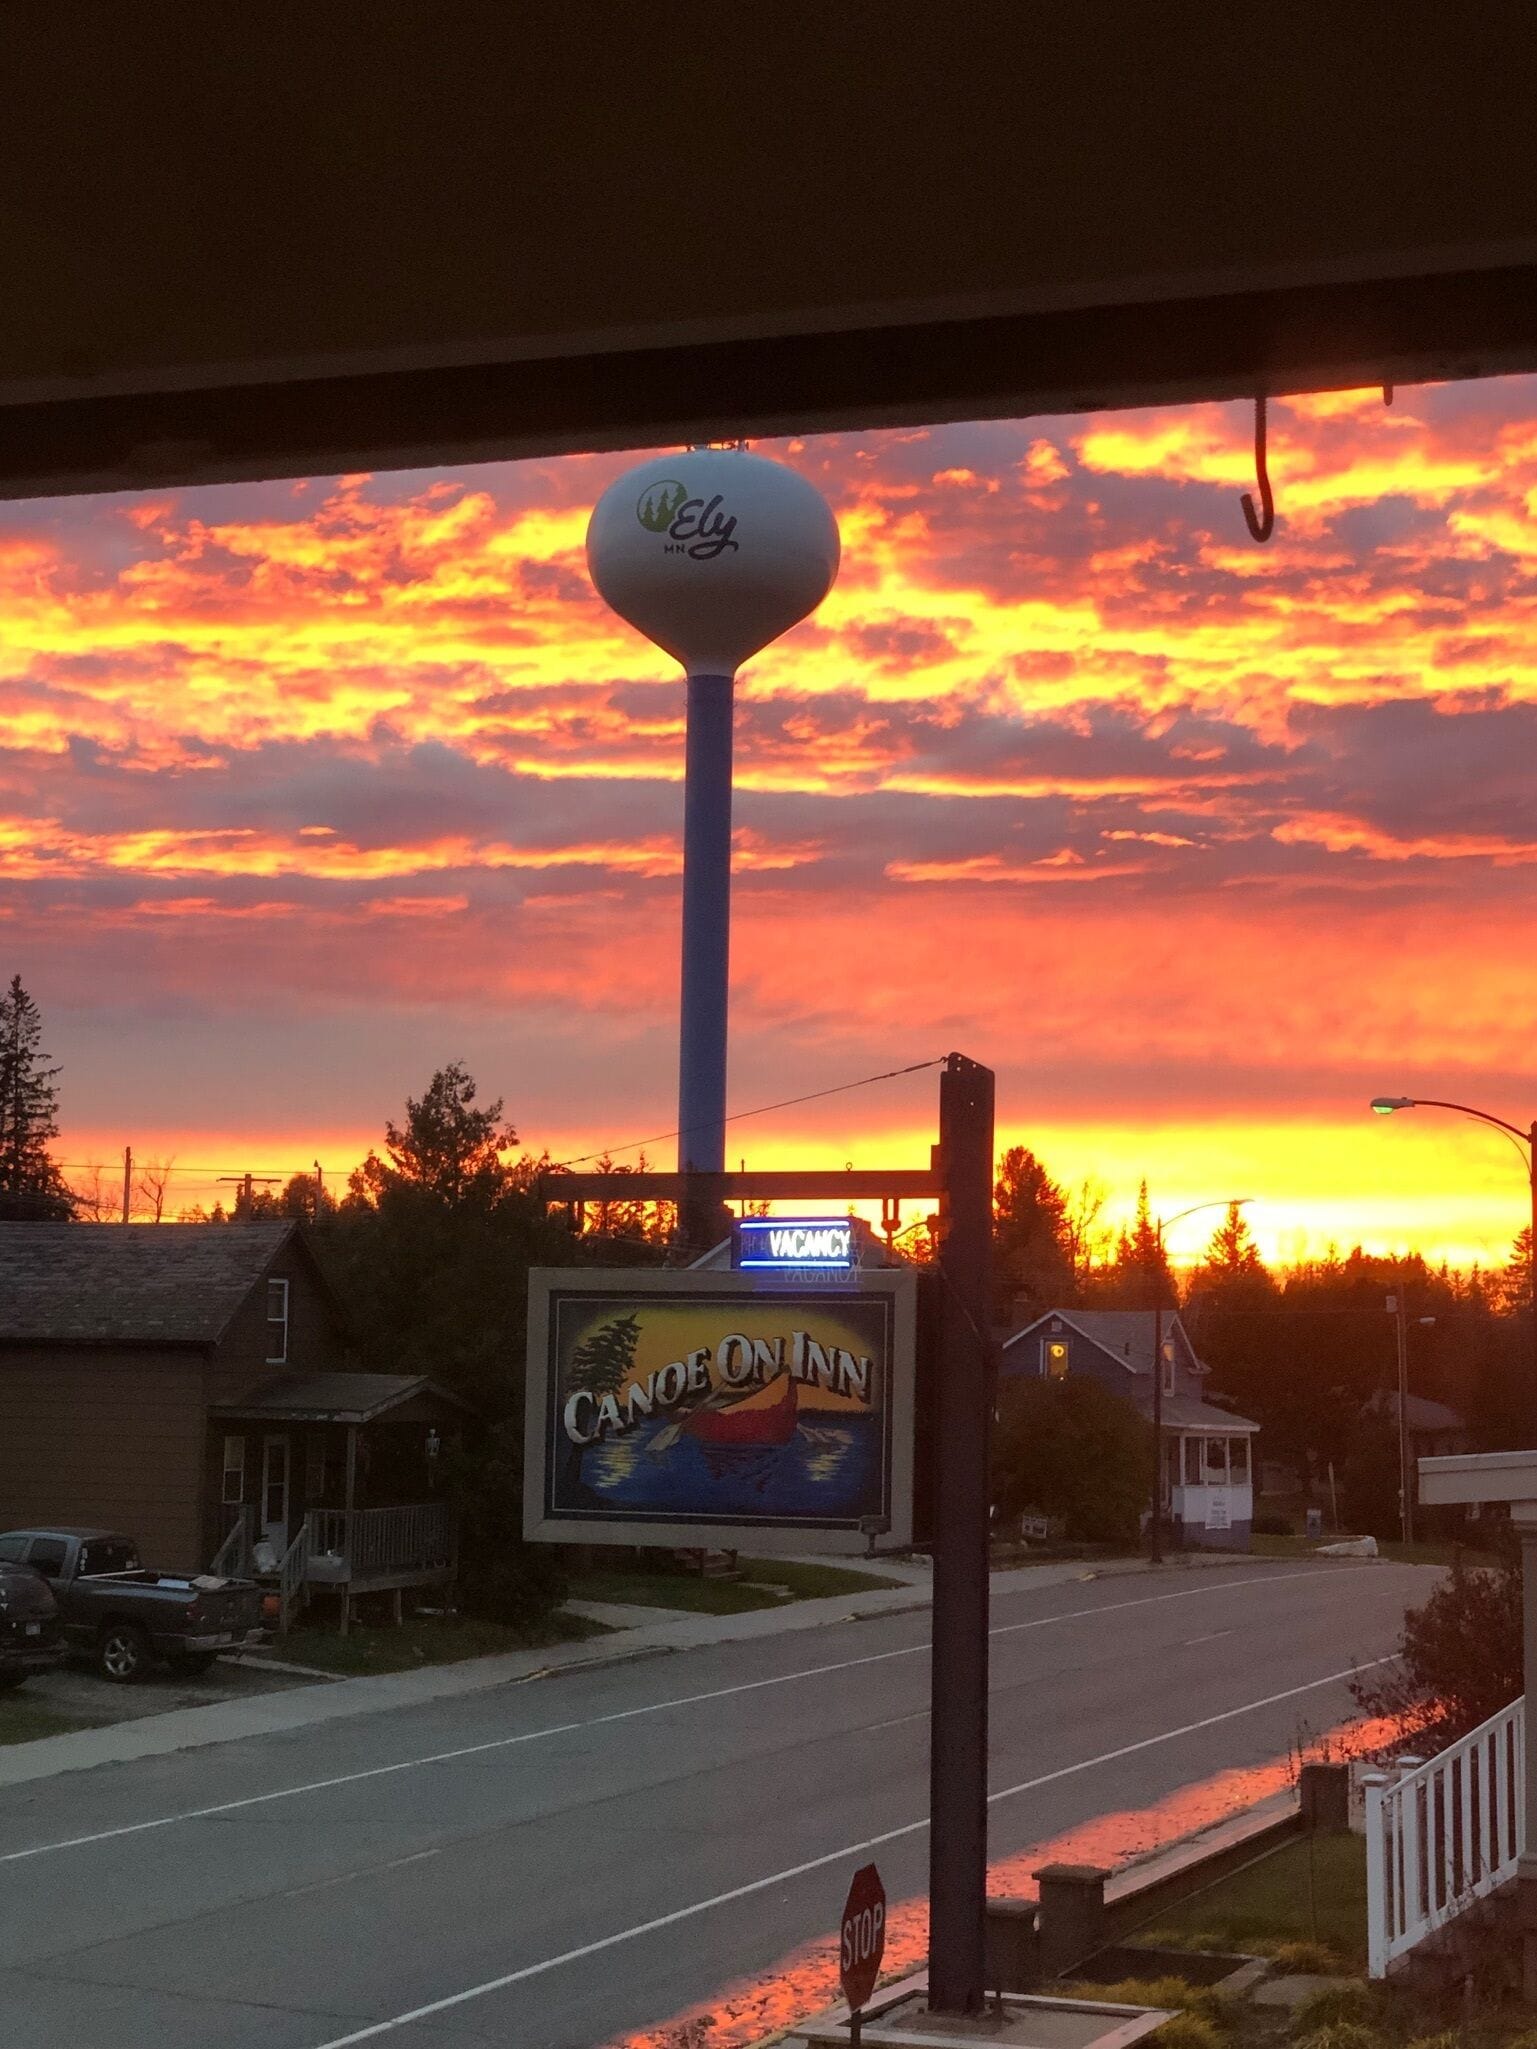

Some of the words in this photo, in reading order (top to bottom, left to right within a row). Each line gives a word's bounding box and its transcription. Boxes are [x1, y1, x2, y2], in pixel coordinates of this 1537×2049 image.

[664, 544, 685, 554] MN
[669, 494, 739, 560] Ely
[769, 1228, 850, 1258] VACANCY
[564, 1348, 710, 1444] CANOE
[717, 1333, 784, 1385] ON
[792, 1331, 872, 1399] INN
[843, 1902, 883, 1972] STOP
